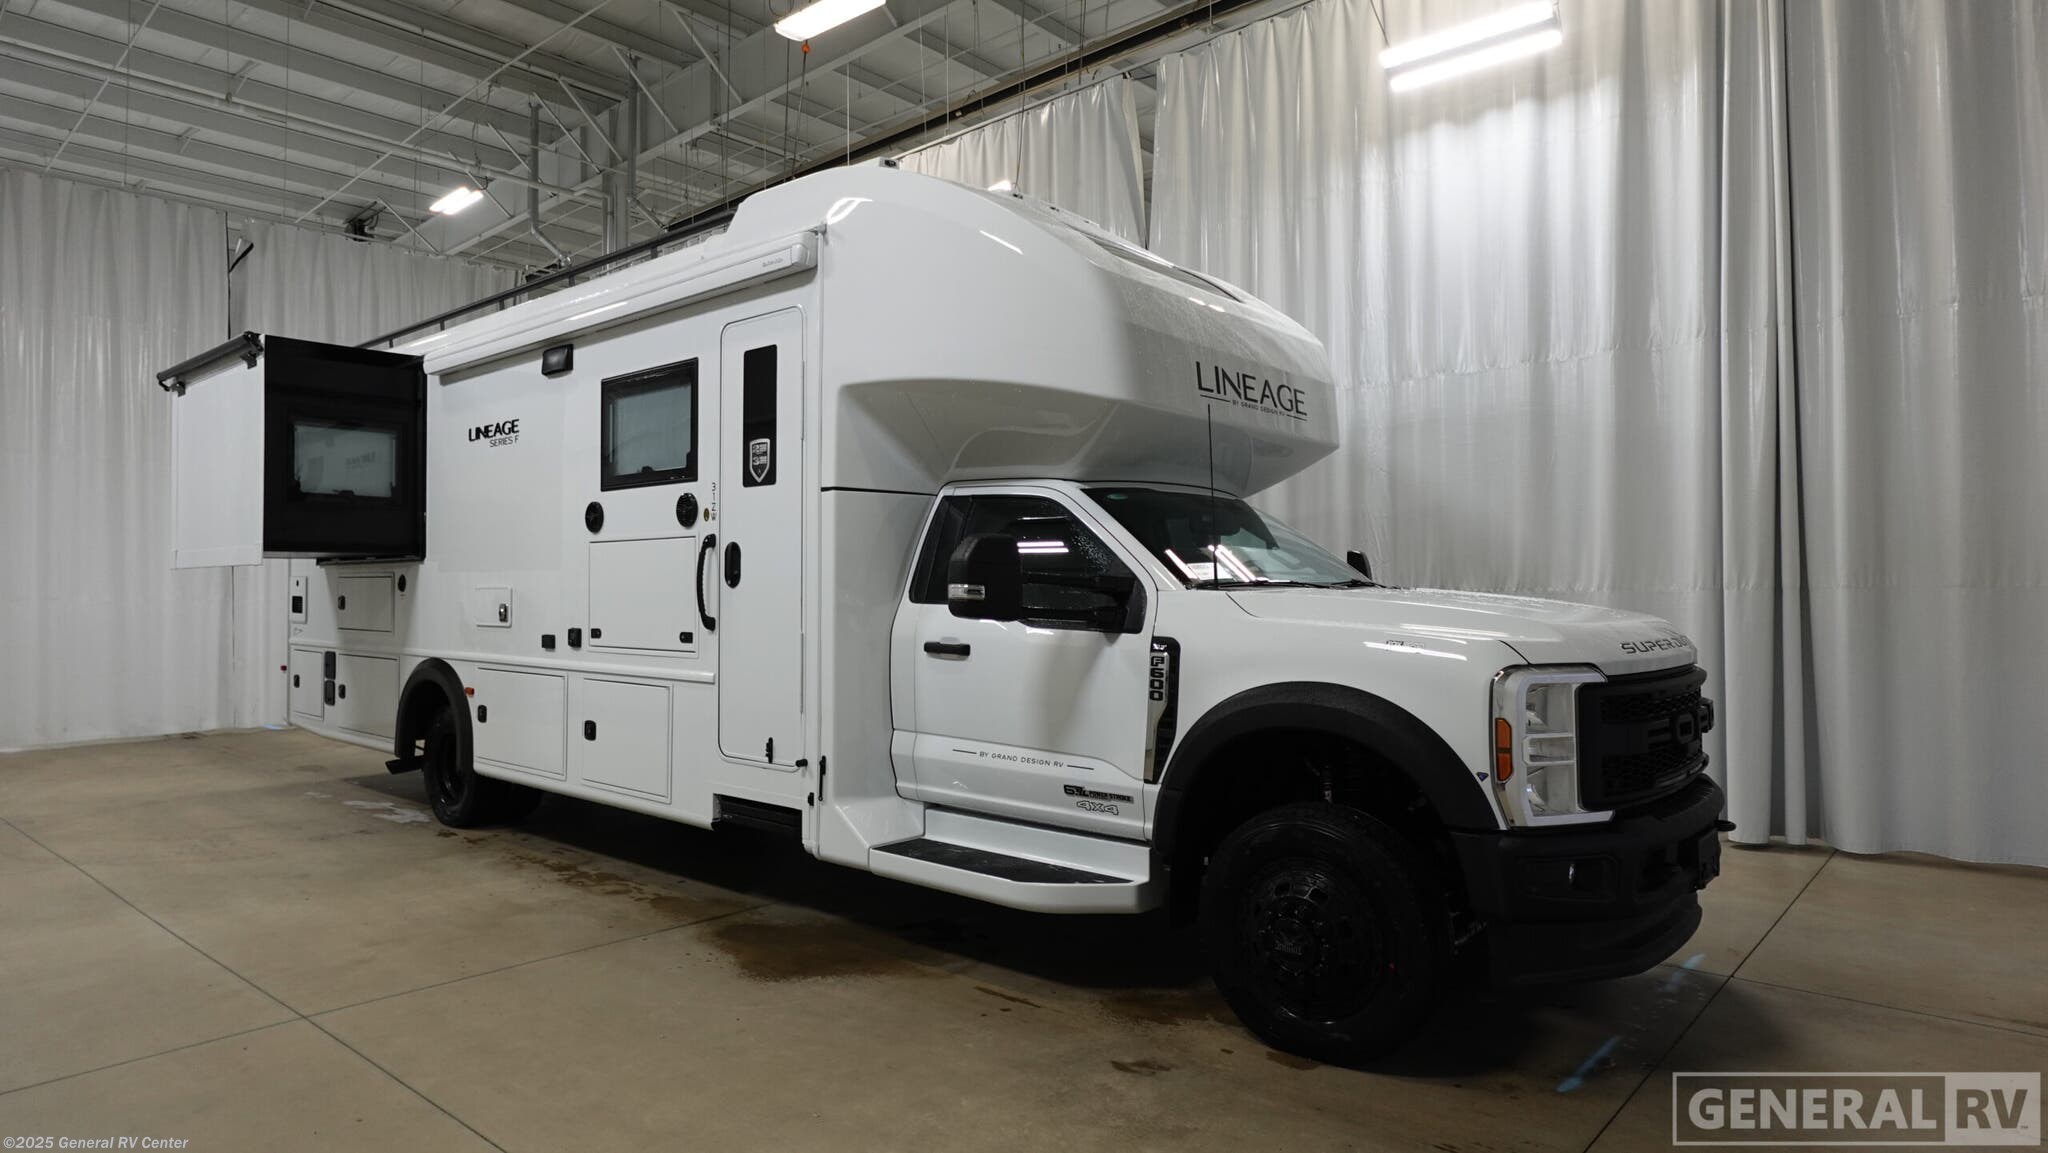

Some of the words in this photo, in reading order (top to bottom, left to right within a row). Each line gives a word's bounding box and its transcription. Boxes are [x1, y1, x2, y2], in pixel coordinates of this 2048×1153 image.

[1195, 361, 1307, 416] LINEAGE
[468, 418, 520, 442] LINEAGE
[489, 436, 513, 447] SERIES
[515, 435, 519, 443] F
[1621, 639, 1676, 654] SUPER
[1150, 656, 1165, 701] F600
[991, 753, 1018, 762] GRAND
[1020, 757, 1051, 767] DESIGN
